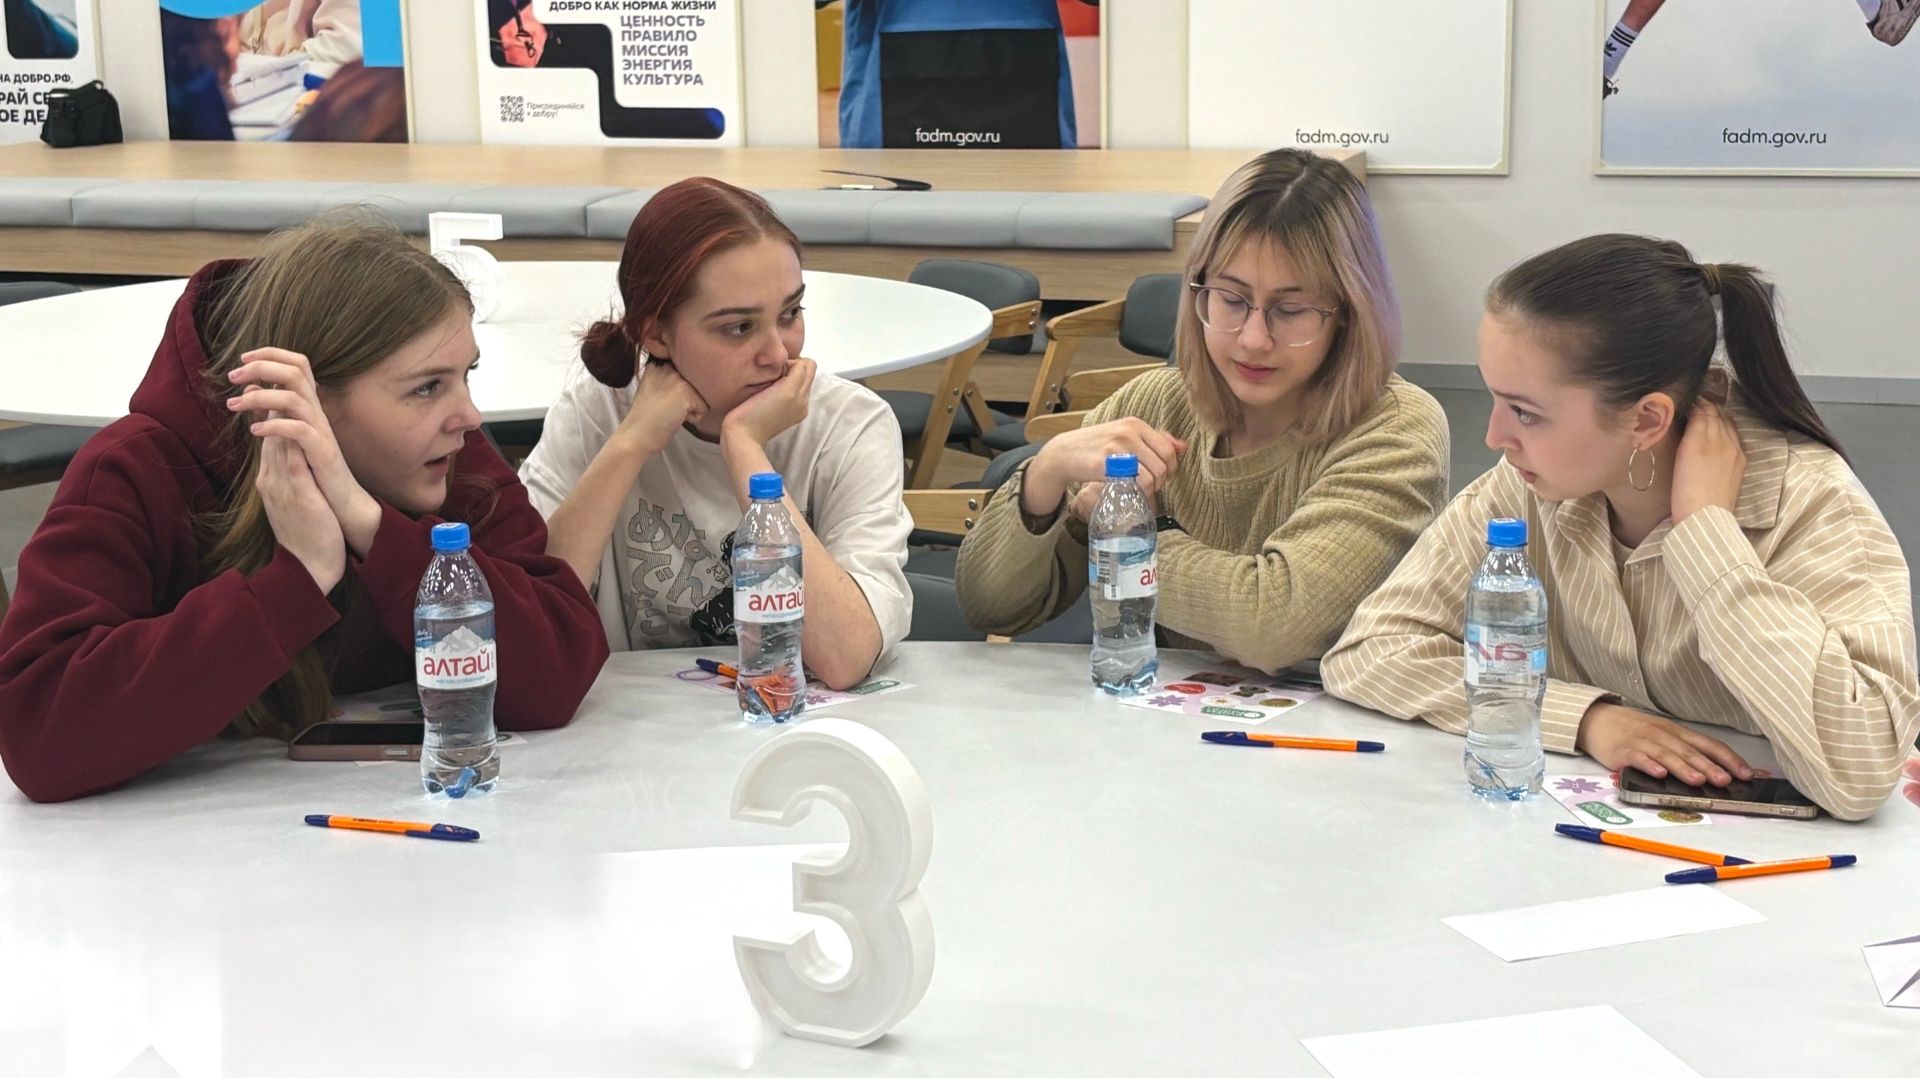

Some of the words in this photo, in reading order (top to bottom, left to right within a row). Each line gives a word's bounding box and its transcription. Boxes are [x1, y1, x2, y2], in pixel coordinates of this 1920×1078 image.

[549, 1, 592, 12] ДОБРО
[594, 1, 620, 11] КАК
[623, 1, 668, 11] НОРМА
[671, 0, 717, 10] ЖИЗНИ
[620, 15, 705, 28] ЦЕННОСТЬ
[621, 30, 697, 42] ПРАВИЛО
[622, 45, 688, 57] МИССИЯ
[622, 59, 693, 71] ЭНЕРГИЯ
[623, 74, 704, 86] КУЛЬТУРА
[915, 127, 1001, 146] fadm.gov.ru
[1295, 128, 1389, 147] fadm.gov.ru
[1722, 127, 1827, 148] fadm.gov.ru
[429, 211, 503, 323] 5
[424, 648, 490, 677] алтай
[730, 717, 935, 1049] 3
